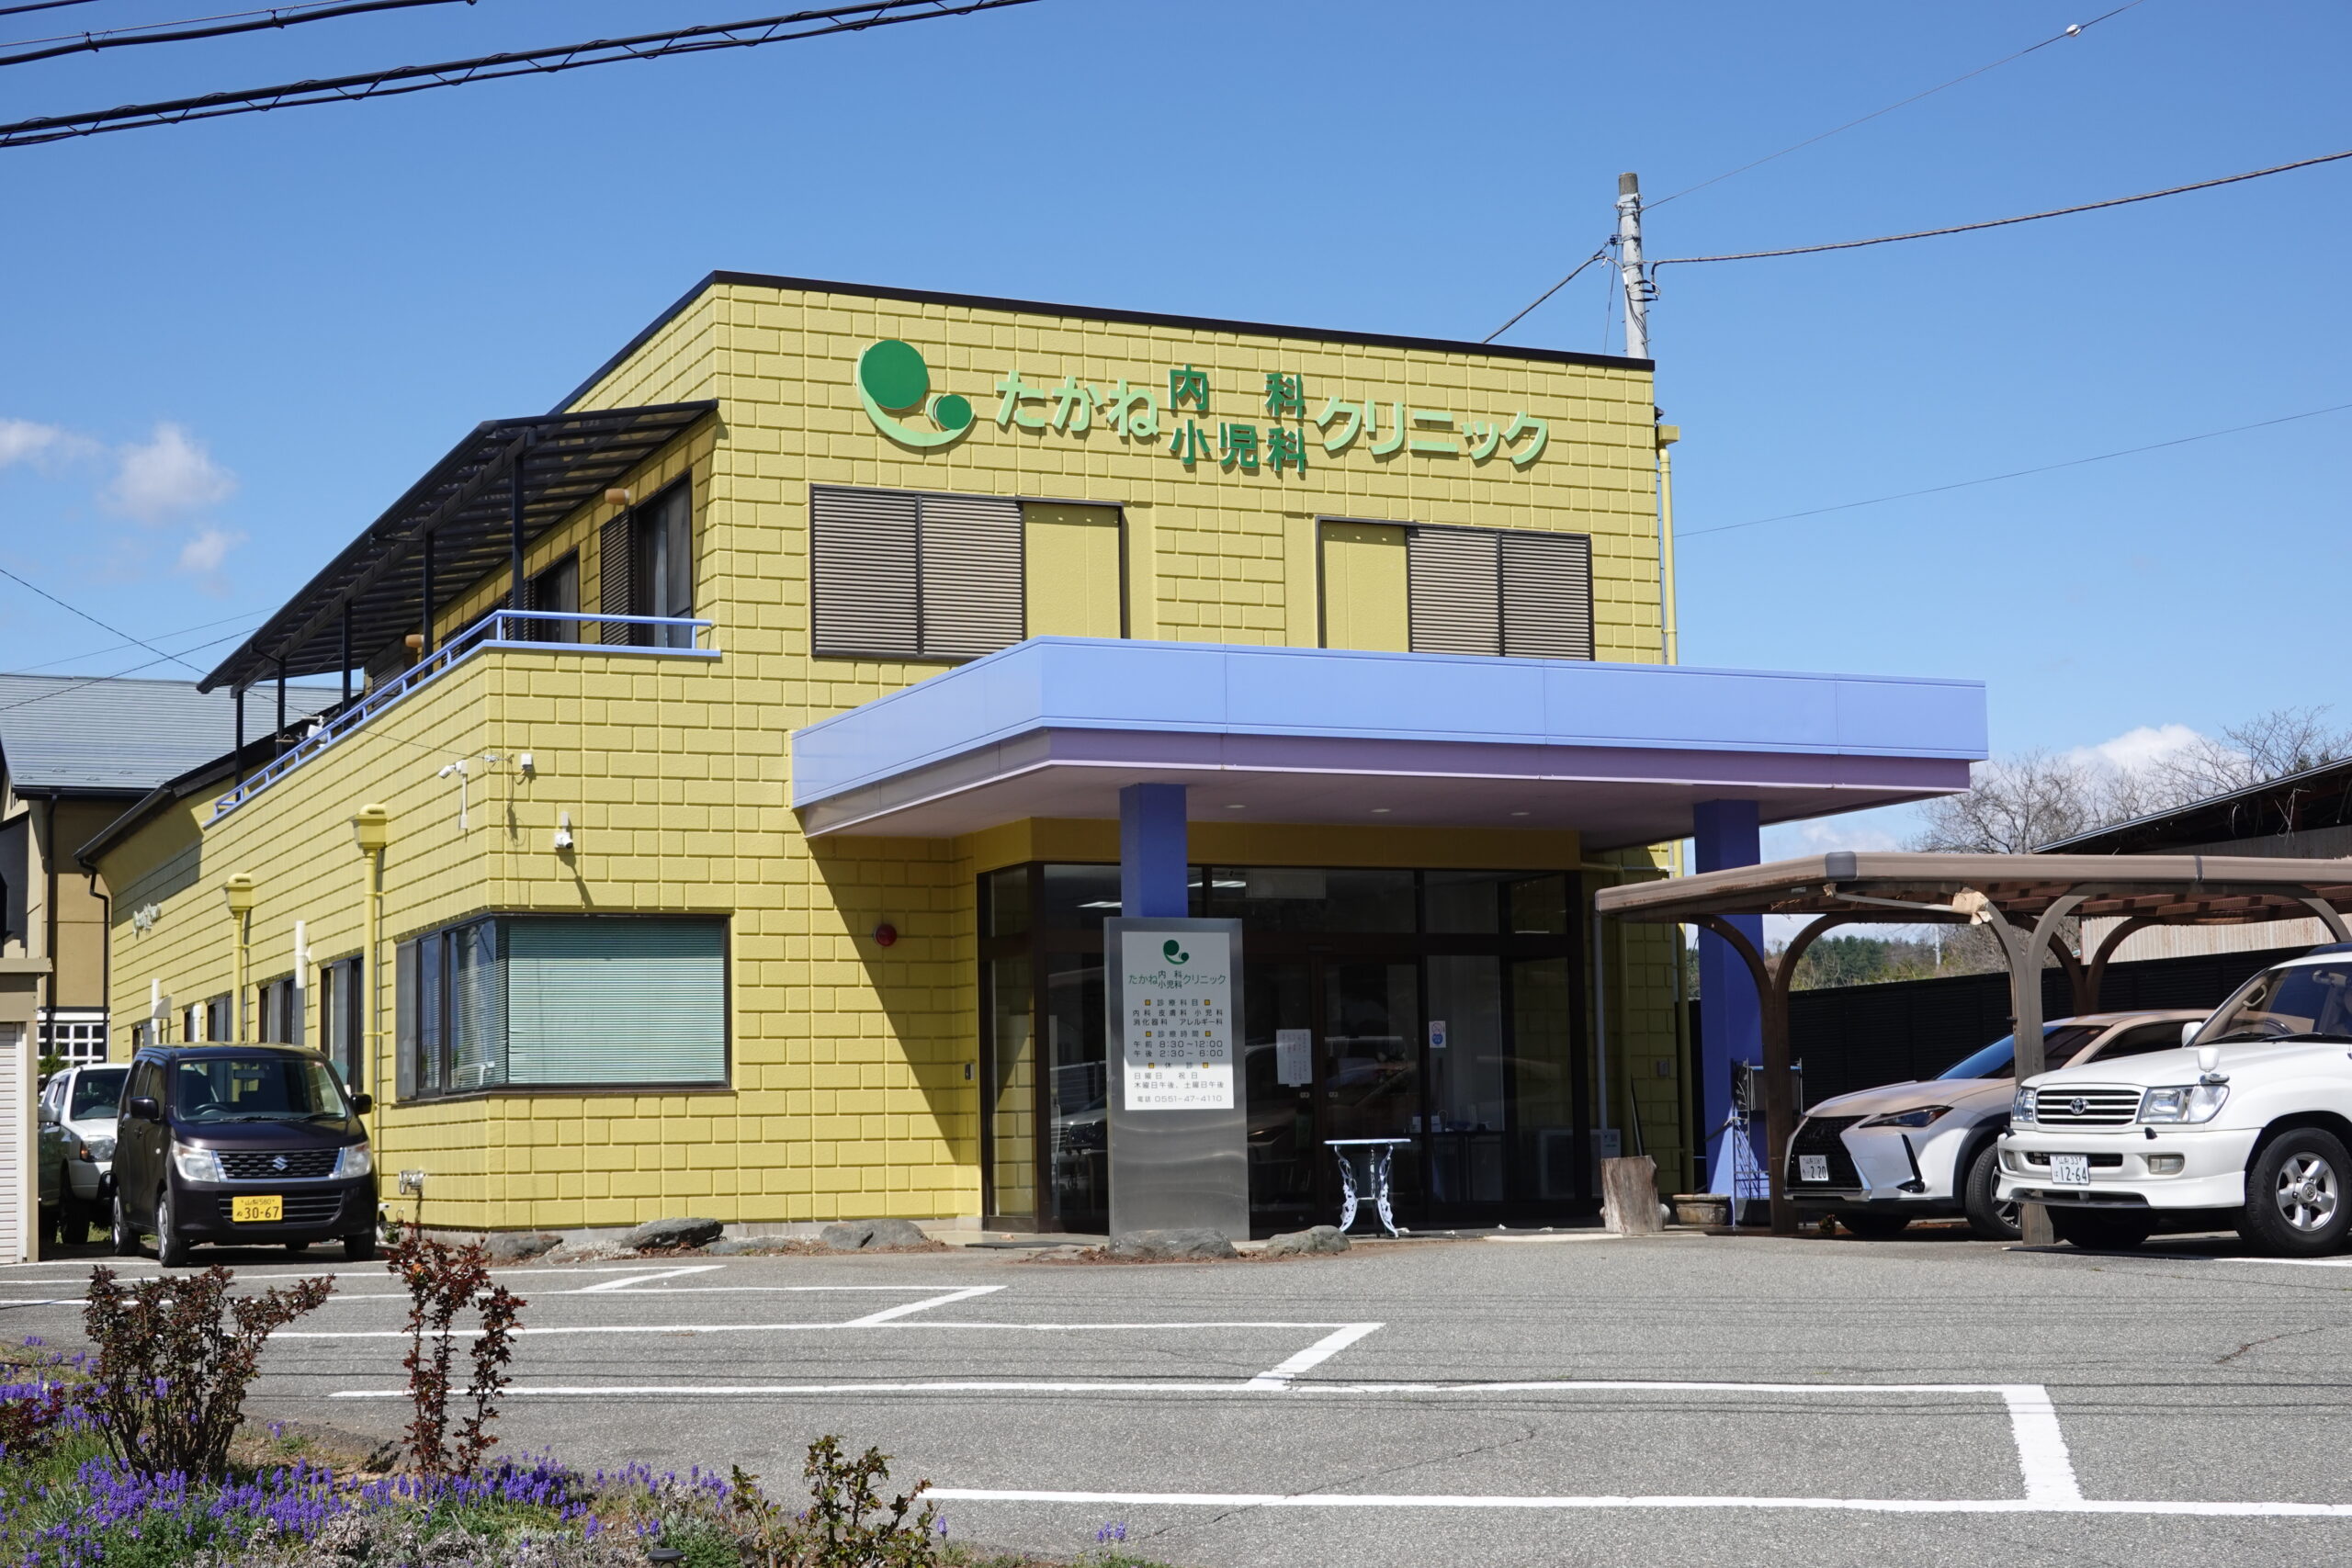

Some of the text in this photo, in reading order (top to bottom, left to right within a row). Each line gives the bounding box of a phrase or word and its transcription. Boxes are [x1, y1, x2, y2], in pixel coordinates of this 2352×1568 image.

[994, 369, 1159, 438] たかね
[1317, 396, 1549, 466] クリニック
[1168, 419, 1307, 473] 小児科
[1128, 975, 1158, 985] たかね
[1182, 974, 1227, 985] クリニック
[1158, 979, 1182, 989] 小児科
